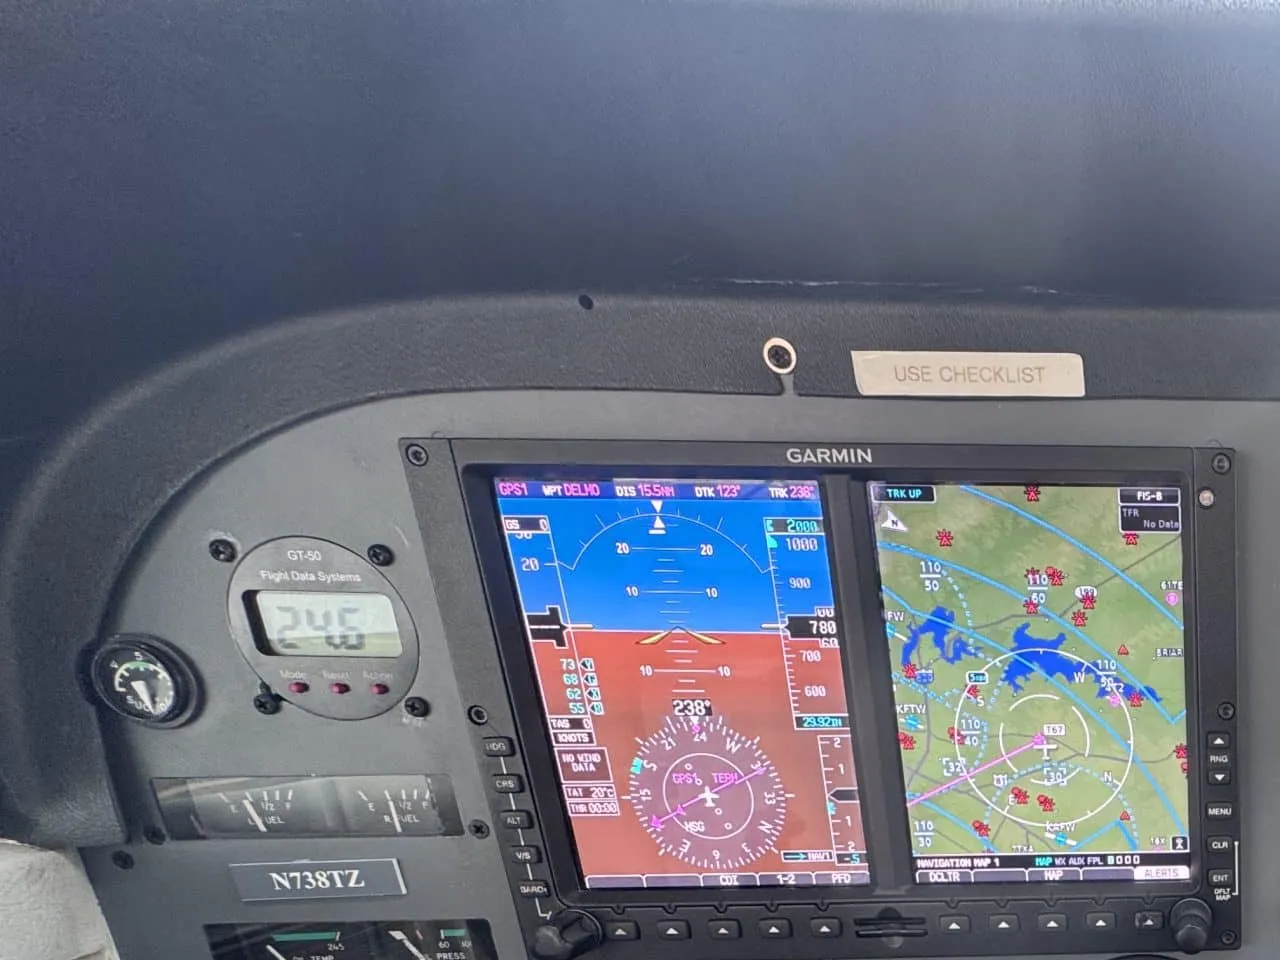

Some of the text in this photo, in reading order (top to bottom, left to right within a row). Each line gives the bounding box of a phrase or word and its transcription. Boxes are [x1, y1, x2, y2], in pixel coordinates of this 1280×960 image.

[894, 366, 1046, 384] USE CHECKLIST
[786, 448, 872, 464] GARMIN
[499, 483, 528, 495] GPS1
[542, 485, 562, 497] WPT
[886, 489, 922, 500] TRK UP
[616, 542, 629, 555] 20
[700, 543, 714, 556] 20
[287, 550, 321, 562] GT-50
[522, 558, 539, 571] 20
[260, 570, 362, 584] Flight Data Systems
[626, 586, 639, 598] 10
[705, 587, 718, 599] 10
[810, 621, 836, 635] 780
[560, 658, 575, 670] 73
[640, 665, 653, 677] 10
[718, 666, 731, 678] 10
[1209, 754, 1229, 764] RNG
[1208, 807, 1232, 817] MENU
[1211, 840, 1229, 850] CLR
[916, 857, 965, 868] NAVIGATION
[268, 869, 366, 891] N738TZ
[1212, 873, 1229, 883] ENT
